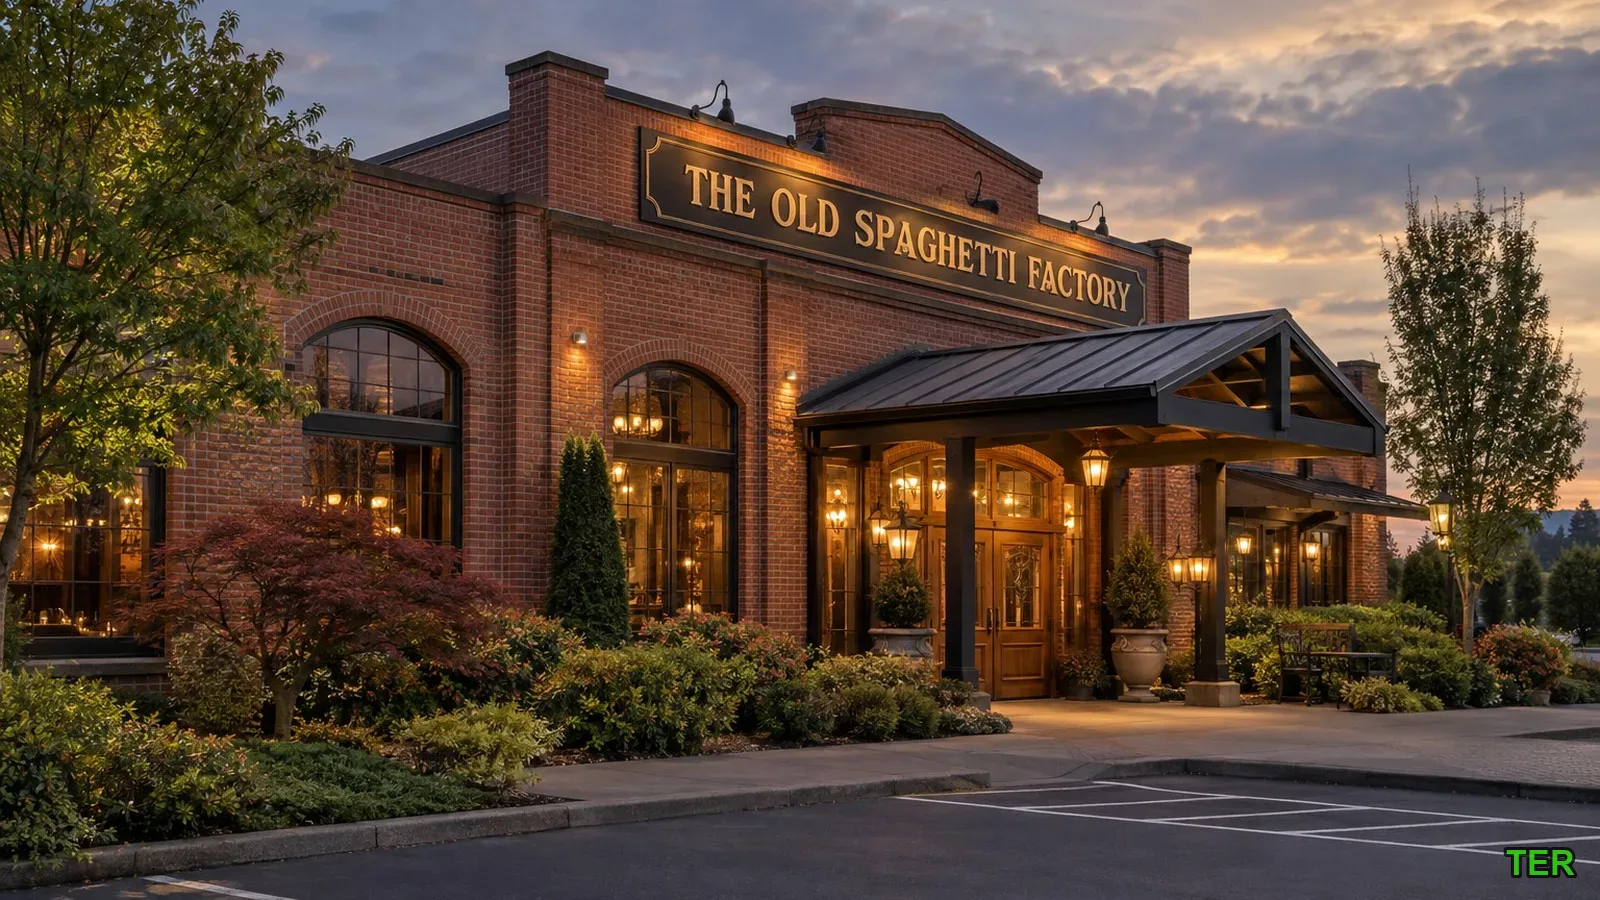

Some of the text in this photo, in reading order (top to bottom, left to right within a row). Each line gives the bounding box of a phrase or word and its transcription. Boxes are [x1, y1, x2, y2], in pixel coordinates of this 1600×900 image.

[684, 163, 1131, 313] THE OLD SPAGHETTI FACTORY
